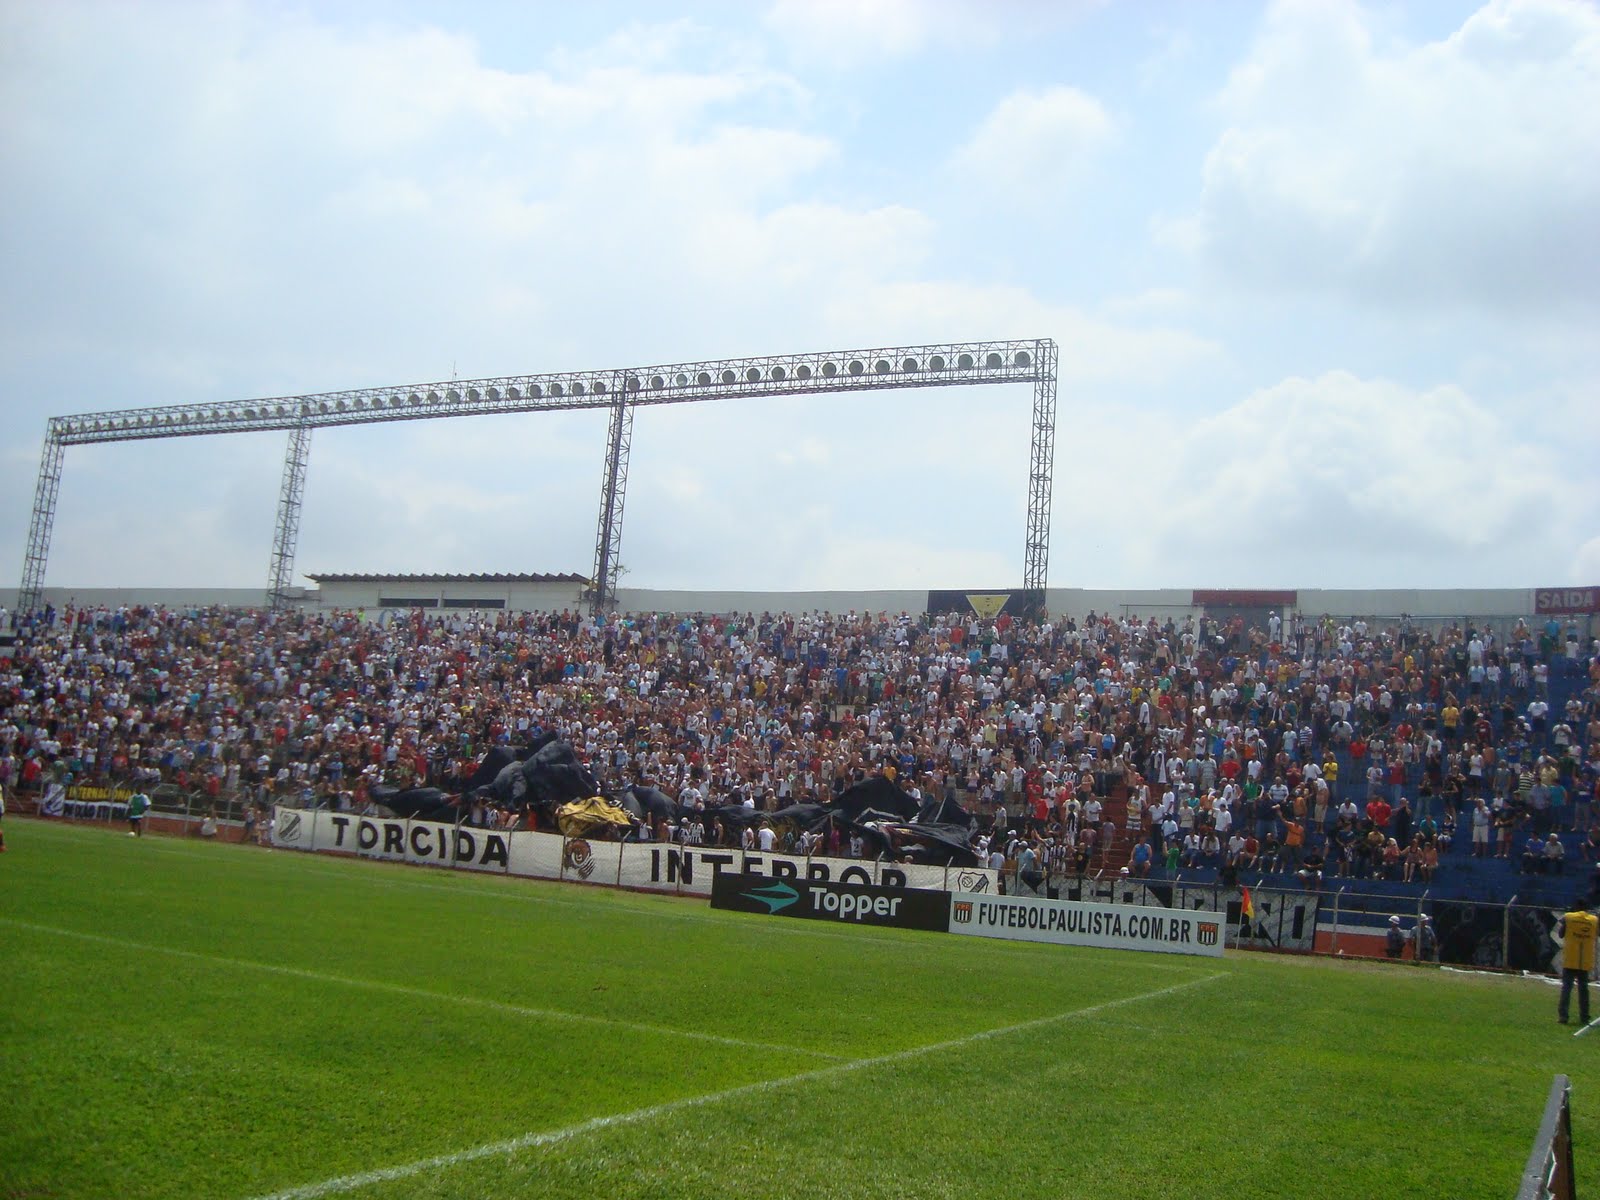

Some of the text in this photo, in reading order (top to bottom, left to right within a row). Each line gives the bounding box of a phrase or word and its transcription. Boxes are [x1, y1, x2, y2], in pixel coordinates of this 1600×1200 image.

[332, 817, 508, 867] TORCIDA
[809, 886, 902, 920] Topper
[979, 903, 1191, 942] FUTEBOLPAULISTA.COM.BR
